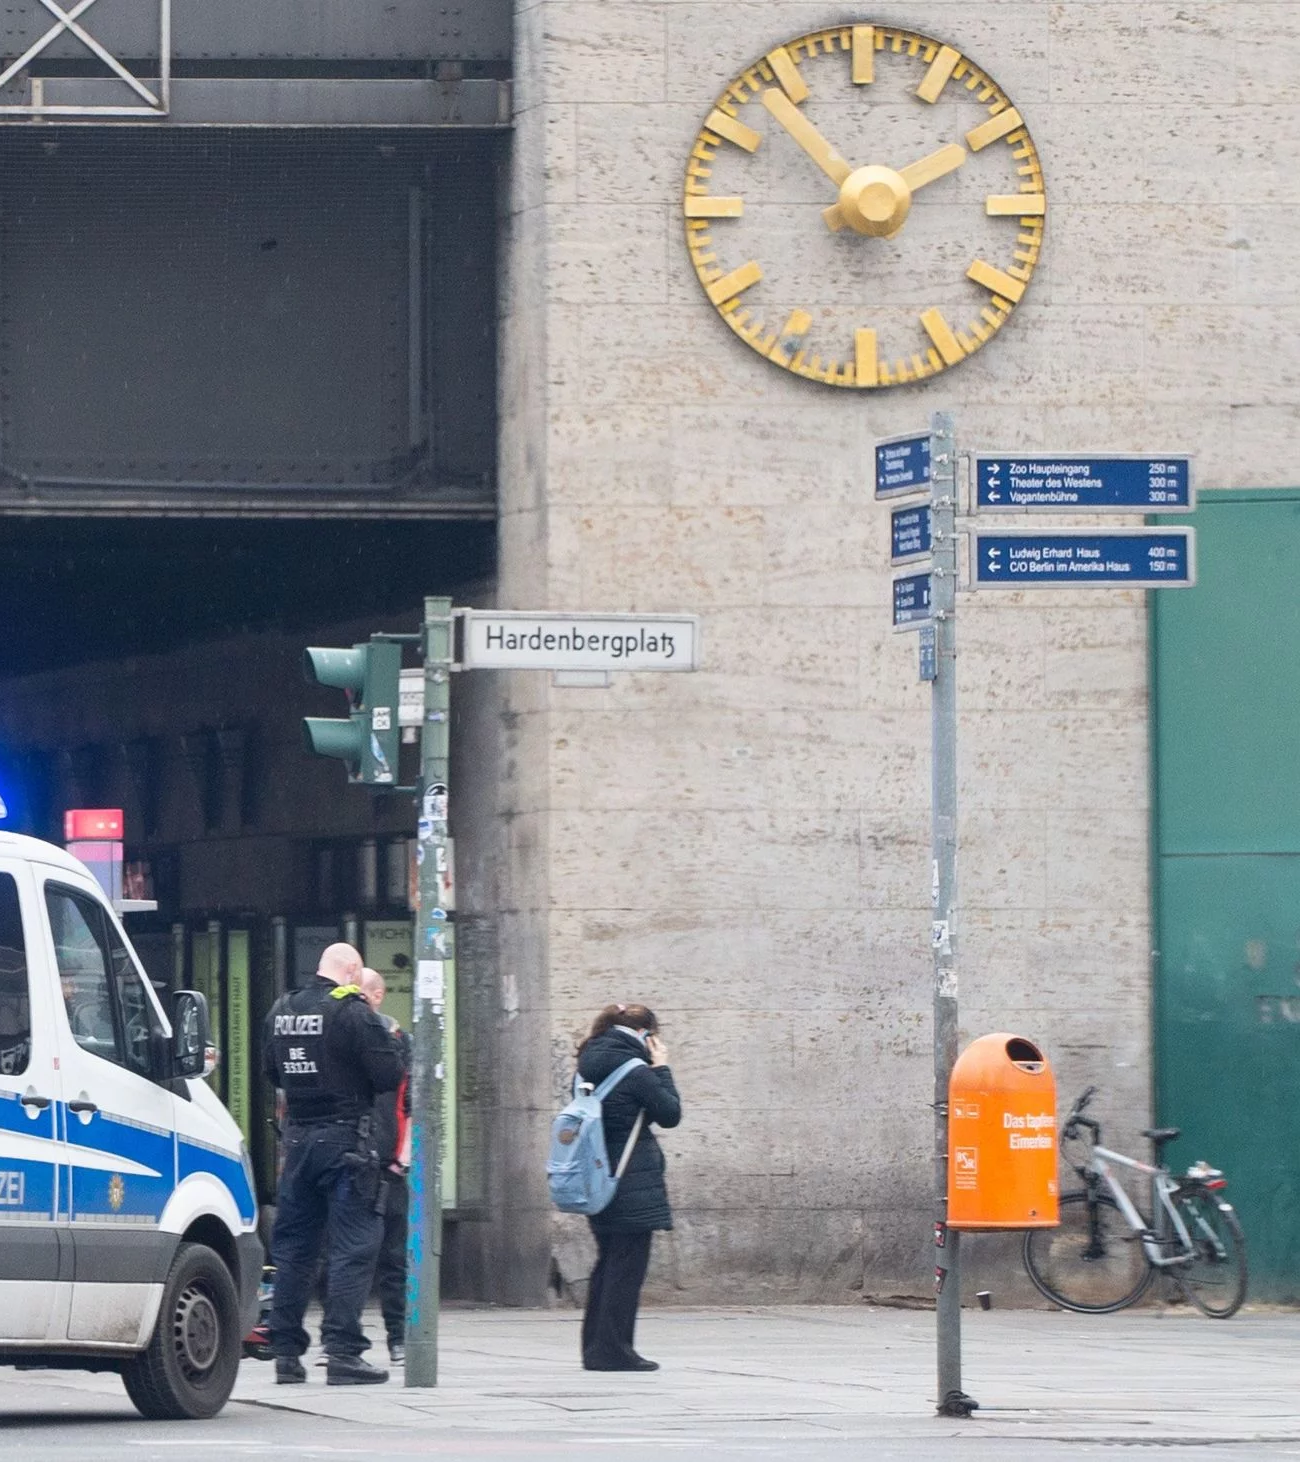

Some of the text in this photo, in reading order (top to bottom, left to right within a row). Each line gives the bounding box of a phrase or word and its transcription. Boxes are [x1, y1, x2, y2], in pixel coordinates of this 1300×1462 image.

[1009, 463, 1177, 476] Zoo Haupteingang 250 m
[1010, 477, 1177, 488] Theater des Westens 300 m
[1010, 491, 1177, 505] Vagantenbühne 300 m
[1009, 547, 1176, 560] Ludwig Erhard Haus 400 m
[1009, 561, 1176, 573] C/O Berlin im Amerika Haus 150 m
[486, 625, 676, 658] Hardenbergplatz
[274, 1015, 324, 1036] POLIZEI
[289, 1047, 307, 1060] BE
[1003, 1112, 1025, 1129] Das
